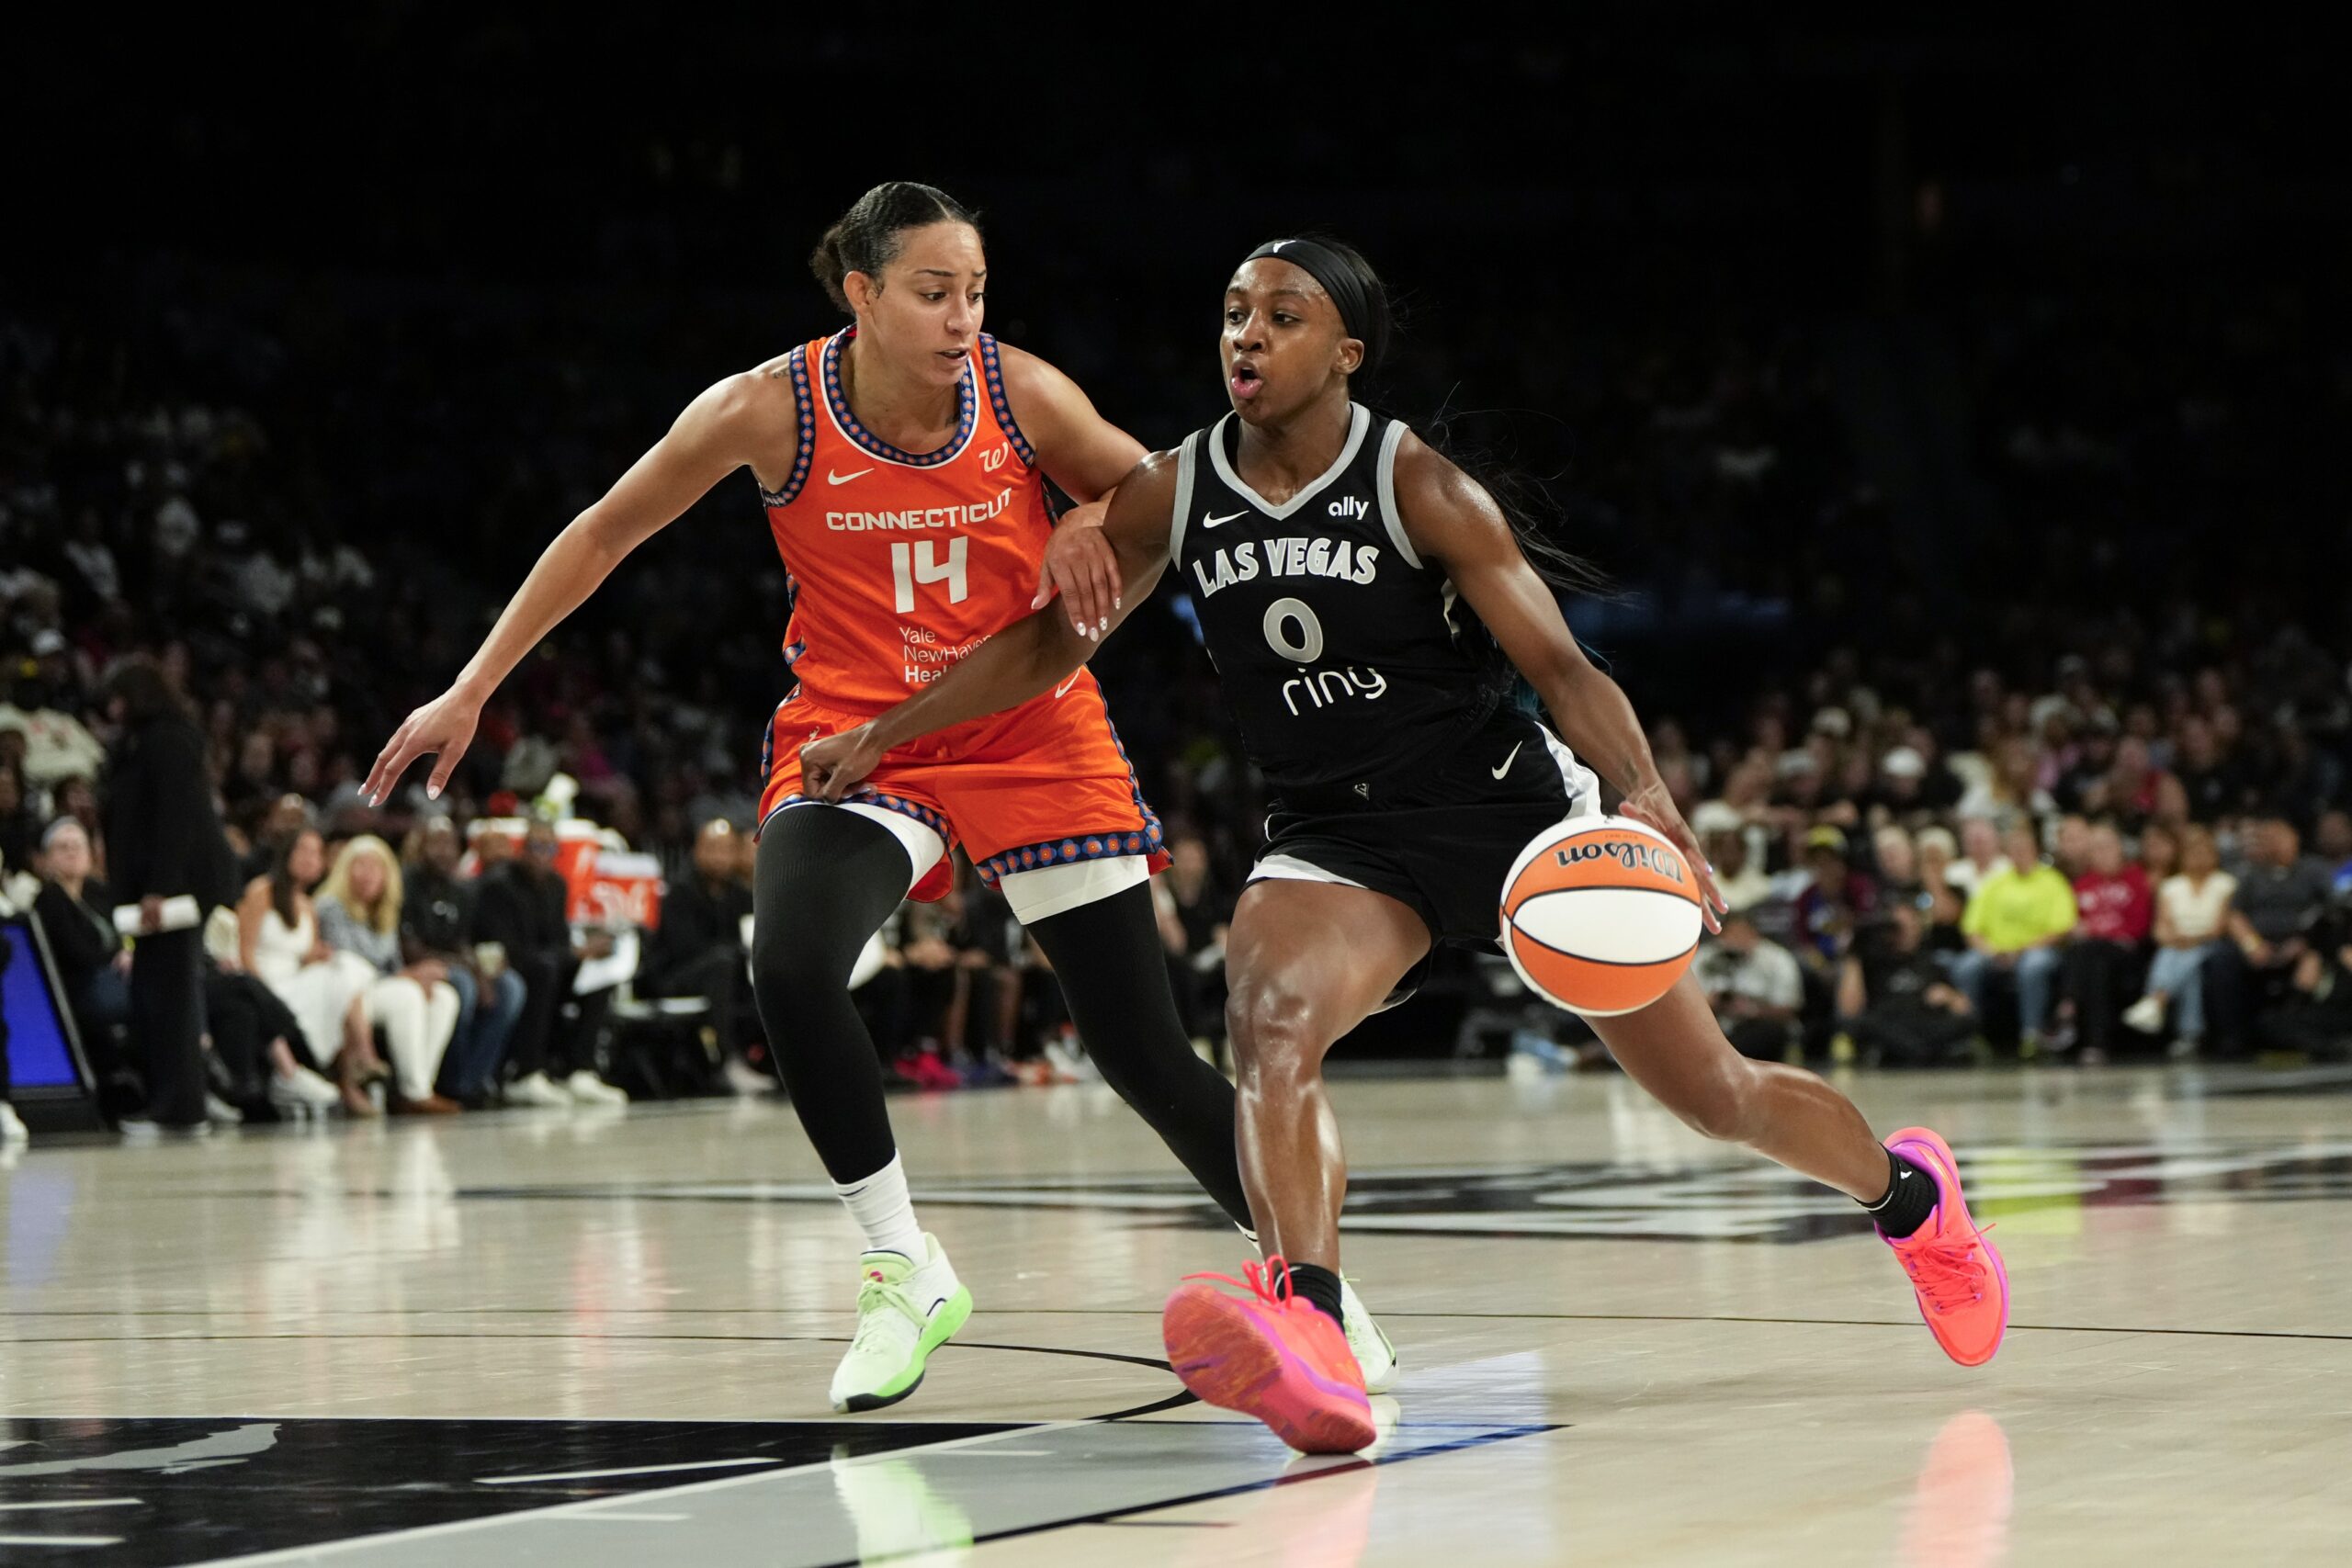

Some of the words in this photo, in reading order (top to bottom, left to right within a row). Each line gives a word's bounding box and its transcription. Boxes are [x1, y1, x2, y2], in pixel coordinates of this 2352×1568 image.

[826, 488, 1012, 531] CONNECTICUT
[1328, 496, 1370, 520] ally
[890, 536, 968, 614] 14
[1193, 542, 1260, 598] LAS
[1263, 537, 1380, 585] VEGAS
[899, 626, 936, 644] Yale
[1263, 597, 1324, 663] 0
[1555, 841, 1683, 884] Wilson
